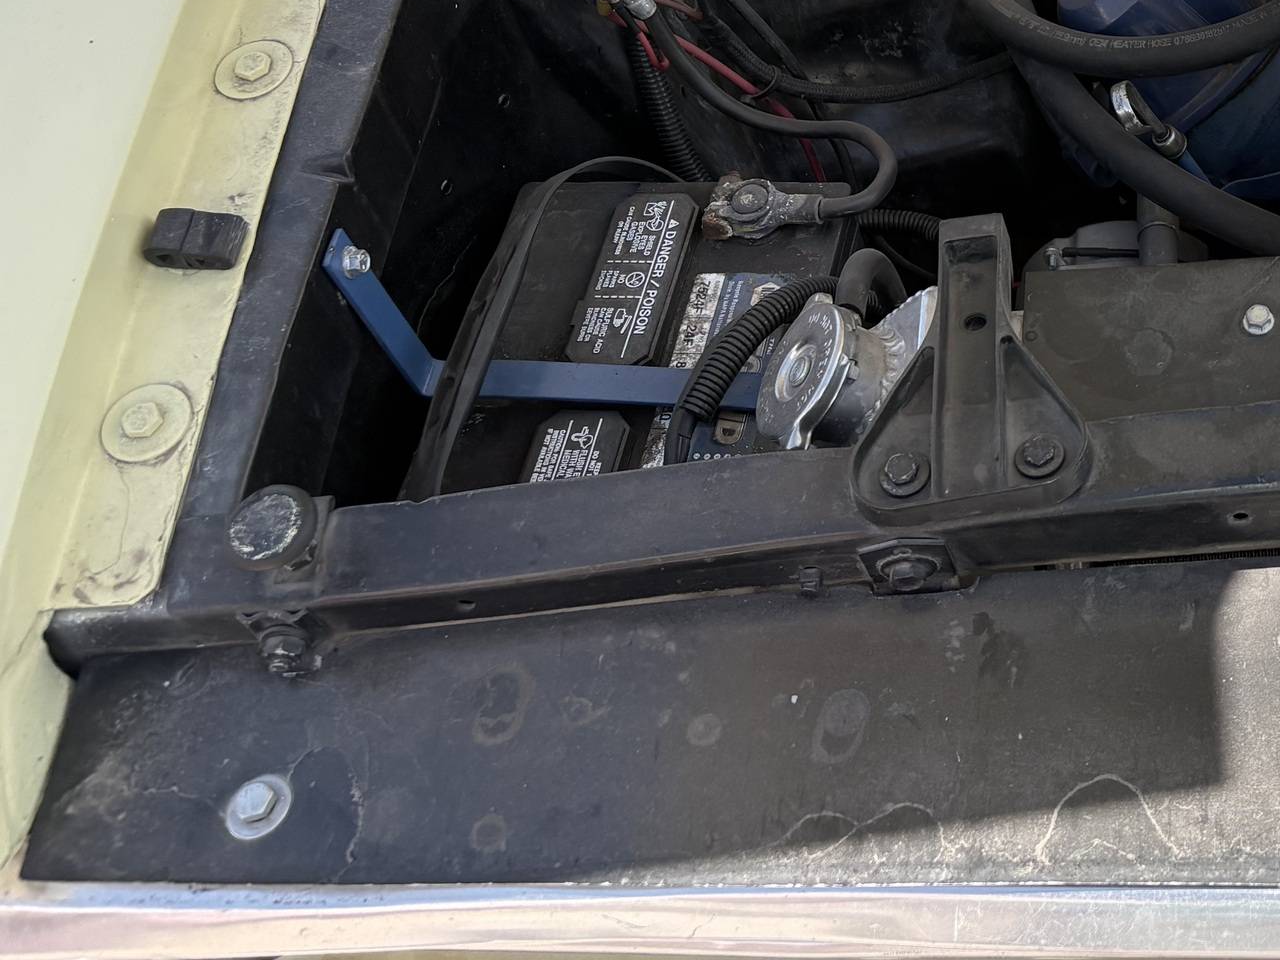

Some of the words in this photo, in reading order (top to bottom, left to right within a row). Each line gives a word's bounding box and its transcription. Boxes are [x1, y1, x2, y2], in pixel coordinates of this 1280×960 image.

[626, 221, 638, 241] GASES
[629, 221, 646, 253] EXPLOSIVE
[637, 234, 649, 250] EYES
[643, 234, 656, 256] SHIELD
[652, 231, 677, 277] DANGER
[617, 274, 627, 284] NO
[693, 280, 711, 314] 7524F
[598, 307, 614, 337] SULFURIC
[633, 289, 658, 335] POISON
[593, 338, 604, 354] ACID
[683, 324, 697, 347] 24F
[557, 449, 573, 478] MEDICAL
[569, 449, 581, 467] WITH
[575, 449, 588, 471] FLUSH
